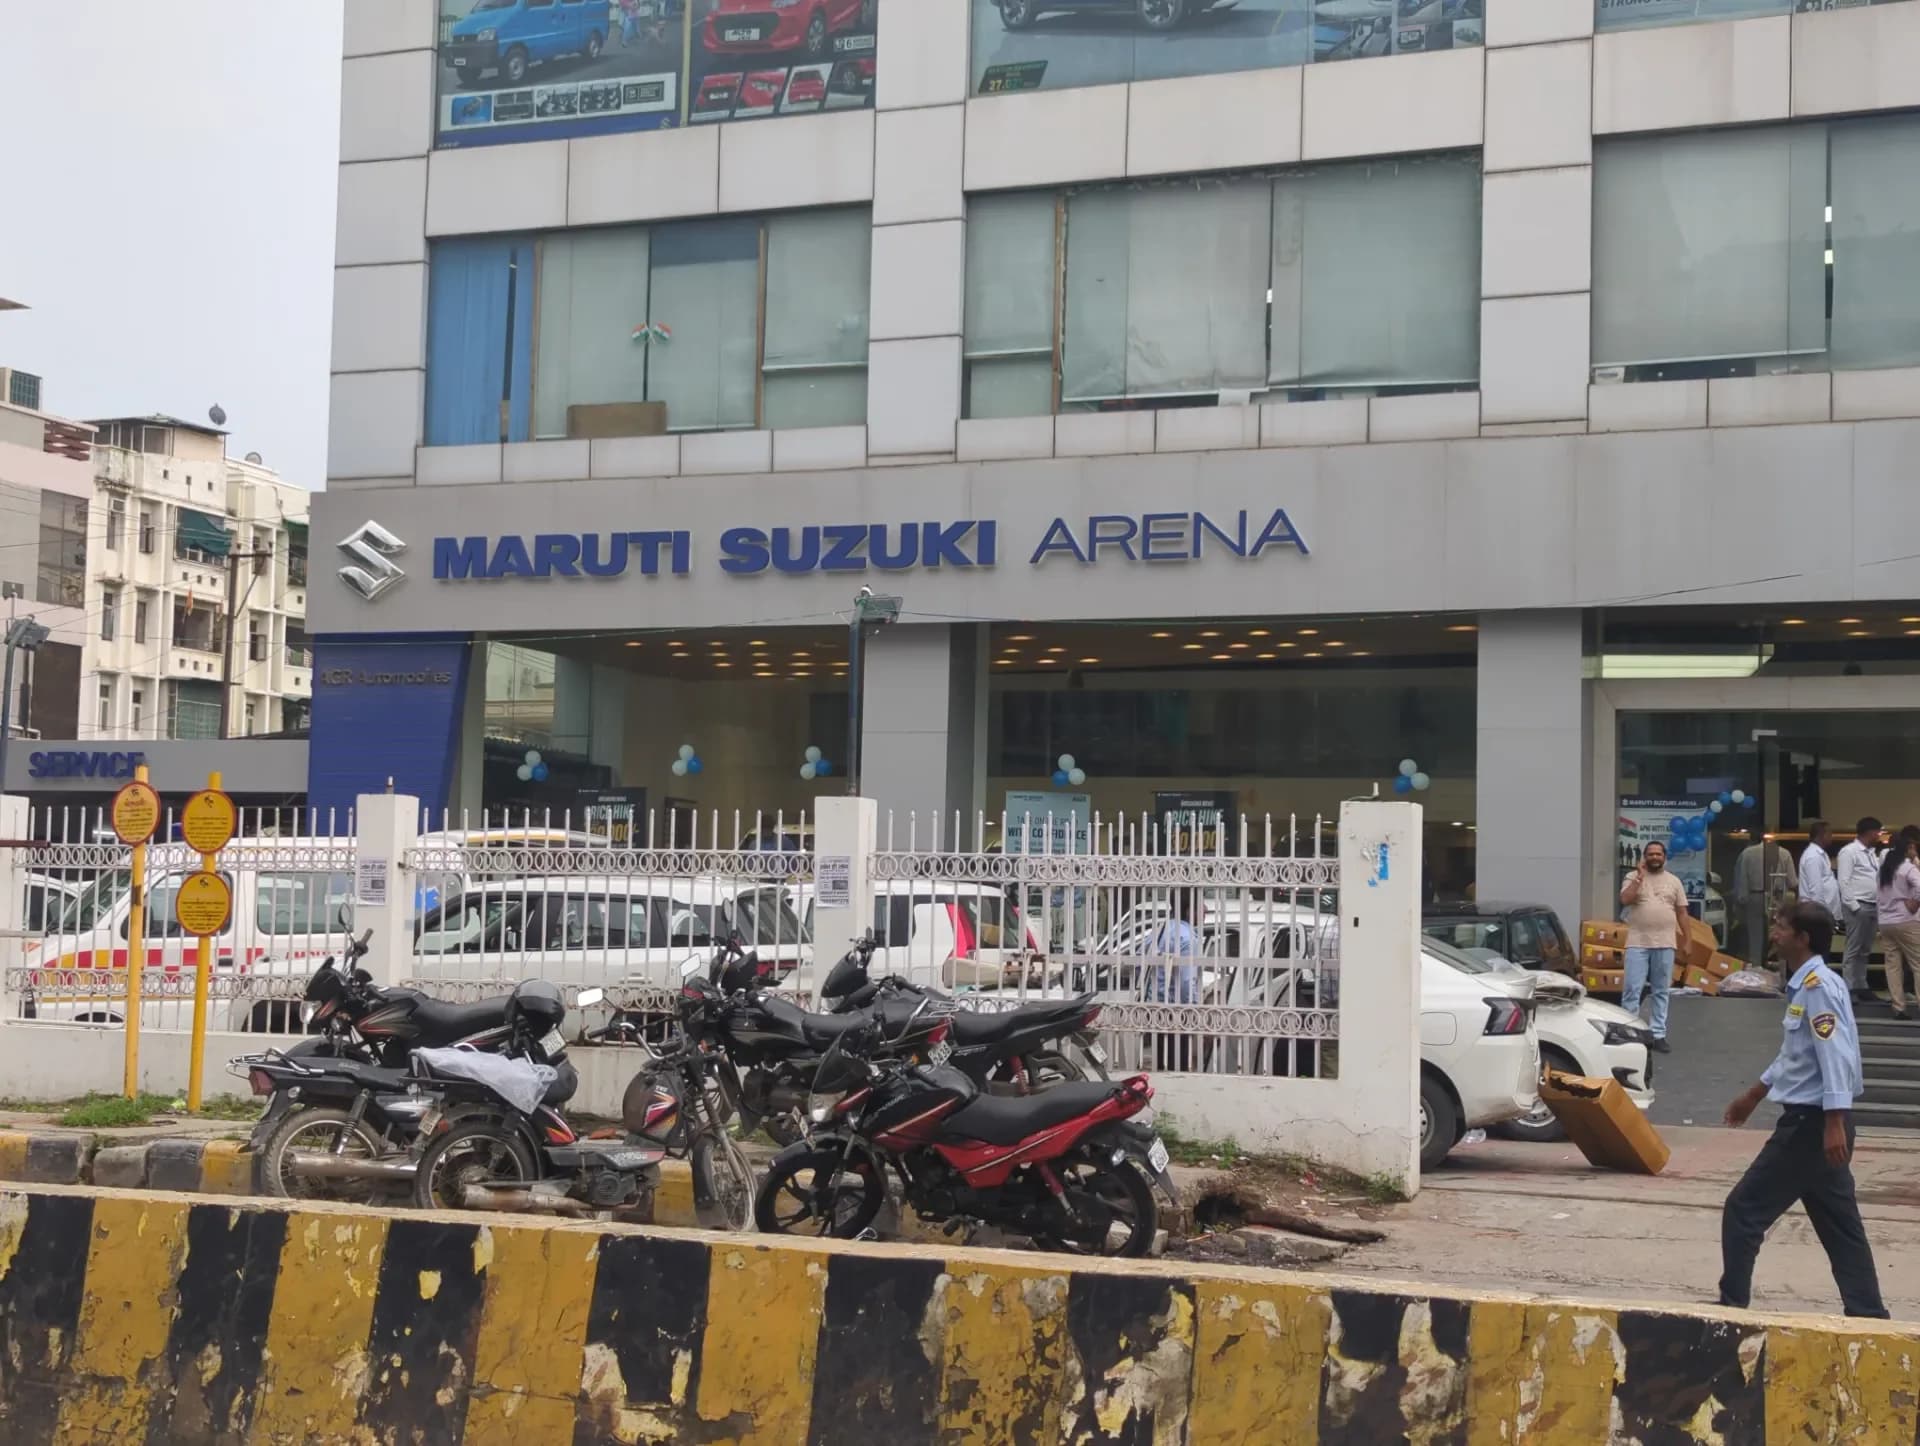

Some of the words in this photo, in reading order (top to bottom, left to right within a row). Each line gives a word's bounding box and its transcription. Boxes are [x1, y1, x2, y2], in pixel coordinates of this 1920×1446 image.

[433, 530, 690, 579] MARUTI
[719, 519, 997, 575] SUZUKI
[1029, 508, 1310, 564] ARENA
[28, 751, 144, 778] SERVICE
[1008, 827, 1026, 837] WIT
[1032, 828, 1088, 840] COFIDCE
